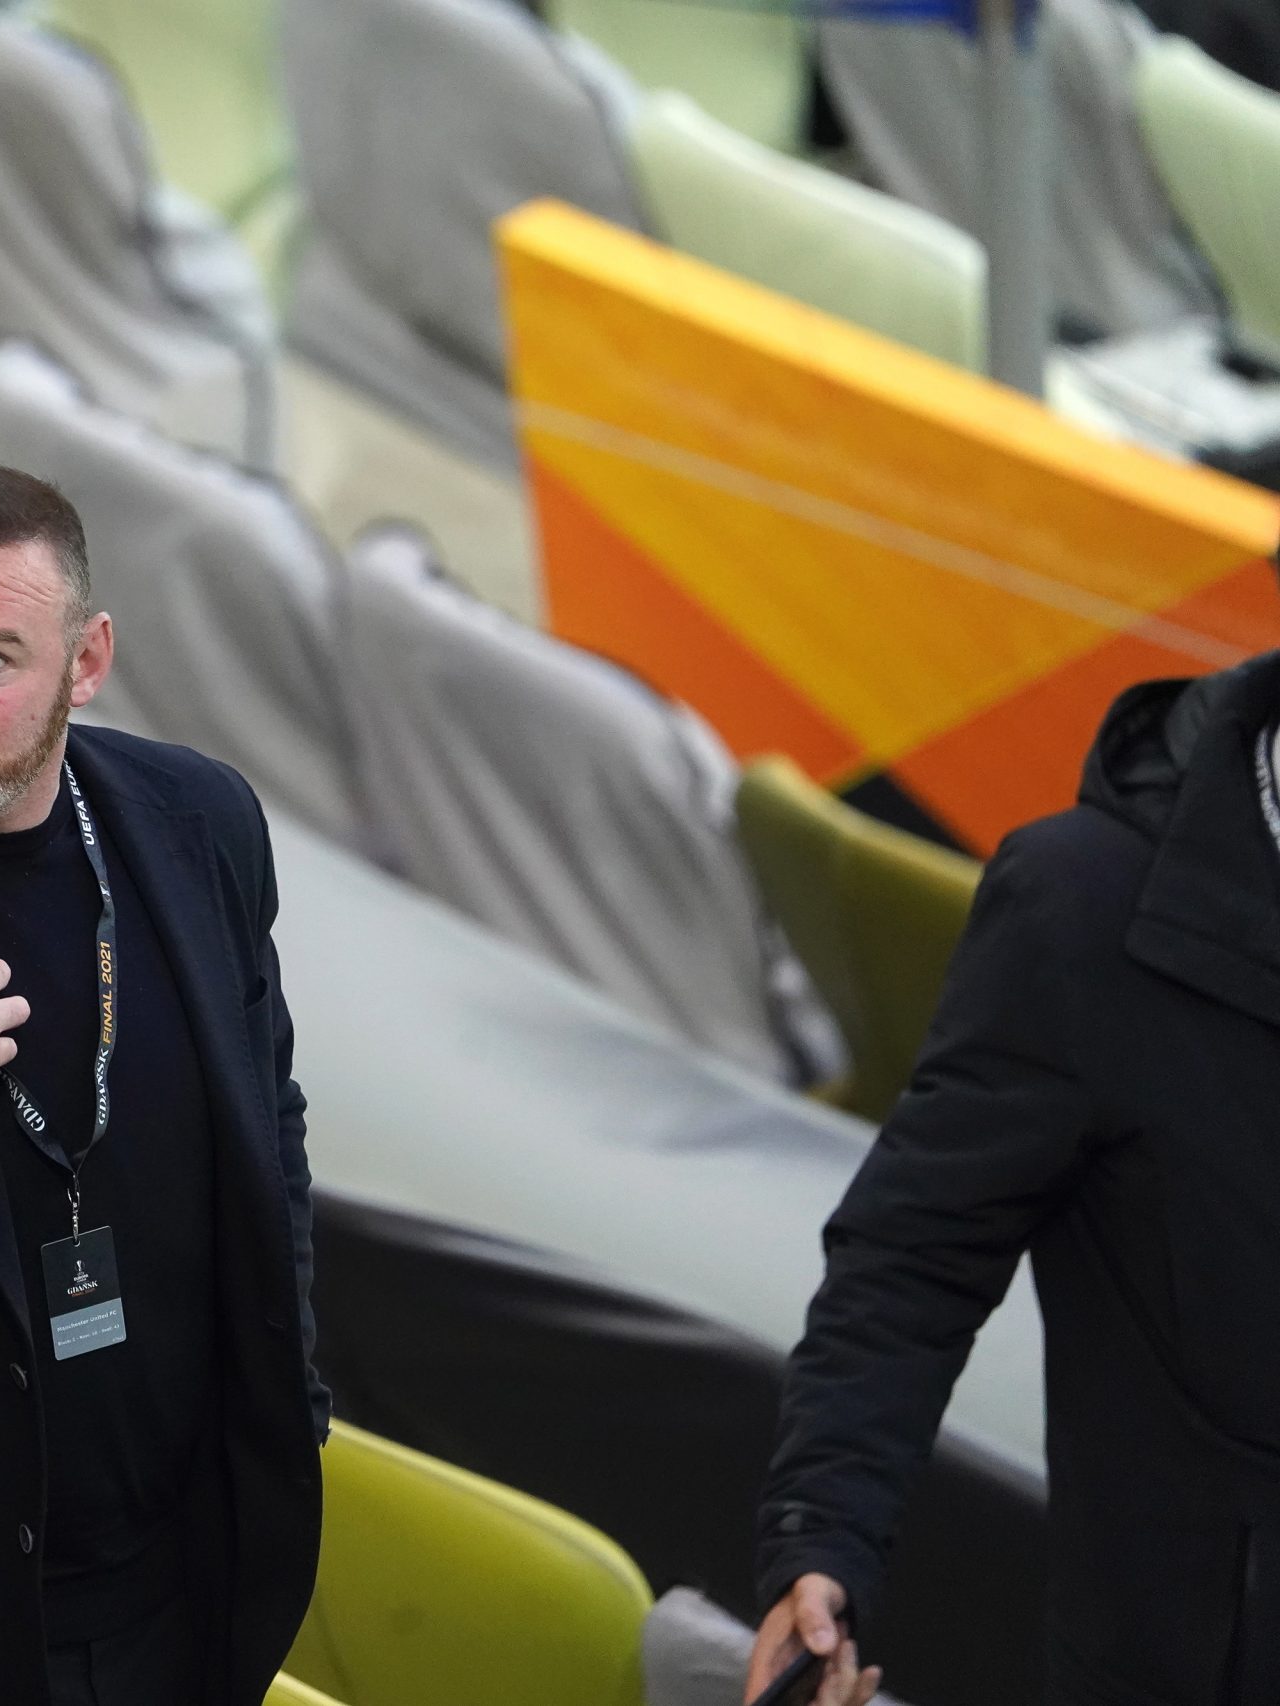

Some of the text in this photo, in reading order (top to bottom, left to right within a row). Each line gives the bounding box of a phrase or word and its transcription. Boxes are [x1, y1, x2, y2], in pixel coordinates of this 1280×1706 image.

[64, 760, 95, 846] UEFA EUR
[100, 941, 112, 985] 2021
[102, 990, 113, 1044] FINAL
[90, 1312, 109, 1322] United
